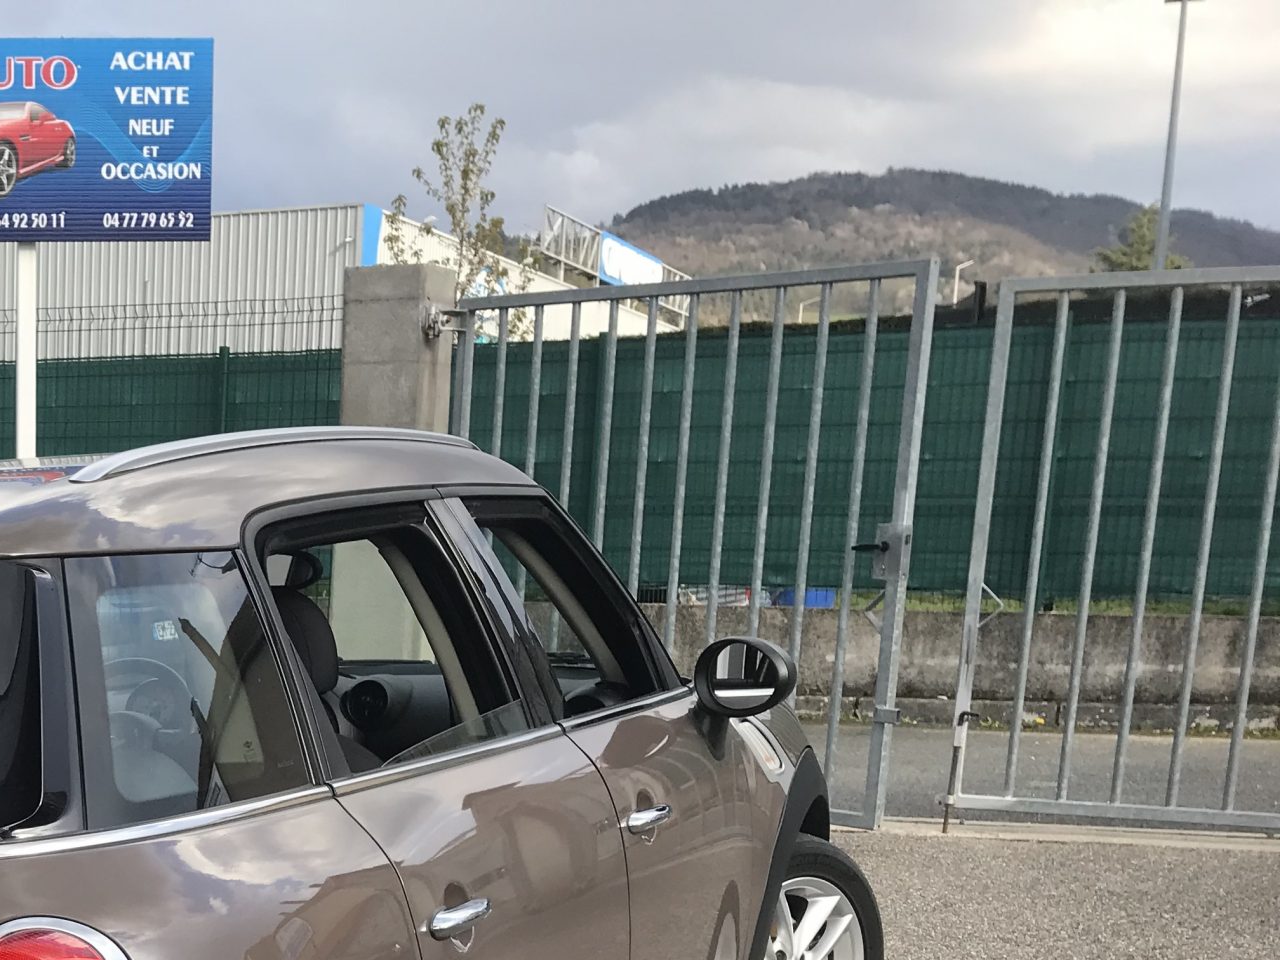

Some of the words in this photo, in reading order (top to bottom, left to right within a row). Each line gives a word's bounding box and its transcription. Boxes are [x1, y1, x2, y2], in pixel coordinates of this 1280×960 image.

[109, 51, 195, 71] ACHAT
[113, 86, 190, 105] VENTE
[128, 119, 175, 136] NEUF
[142, 145, 160, 158] ET
[100, 162, 202, 180] OCCASION
[12, 213, 28, 229] 92
[103, 213, 120, 229] 04
[122, 213, 138, 229] 77
[141, 213, 156, 229] 79
